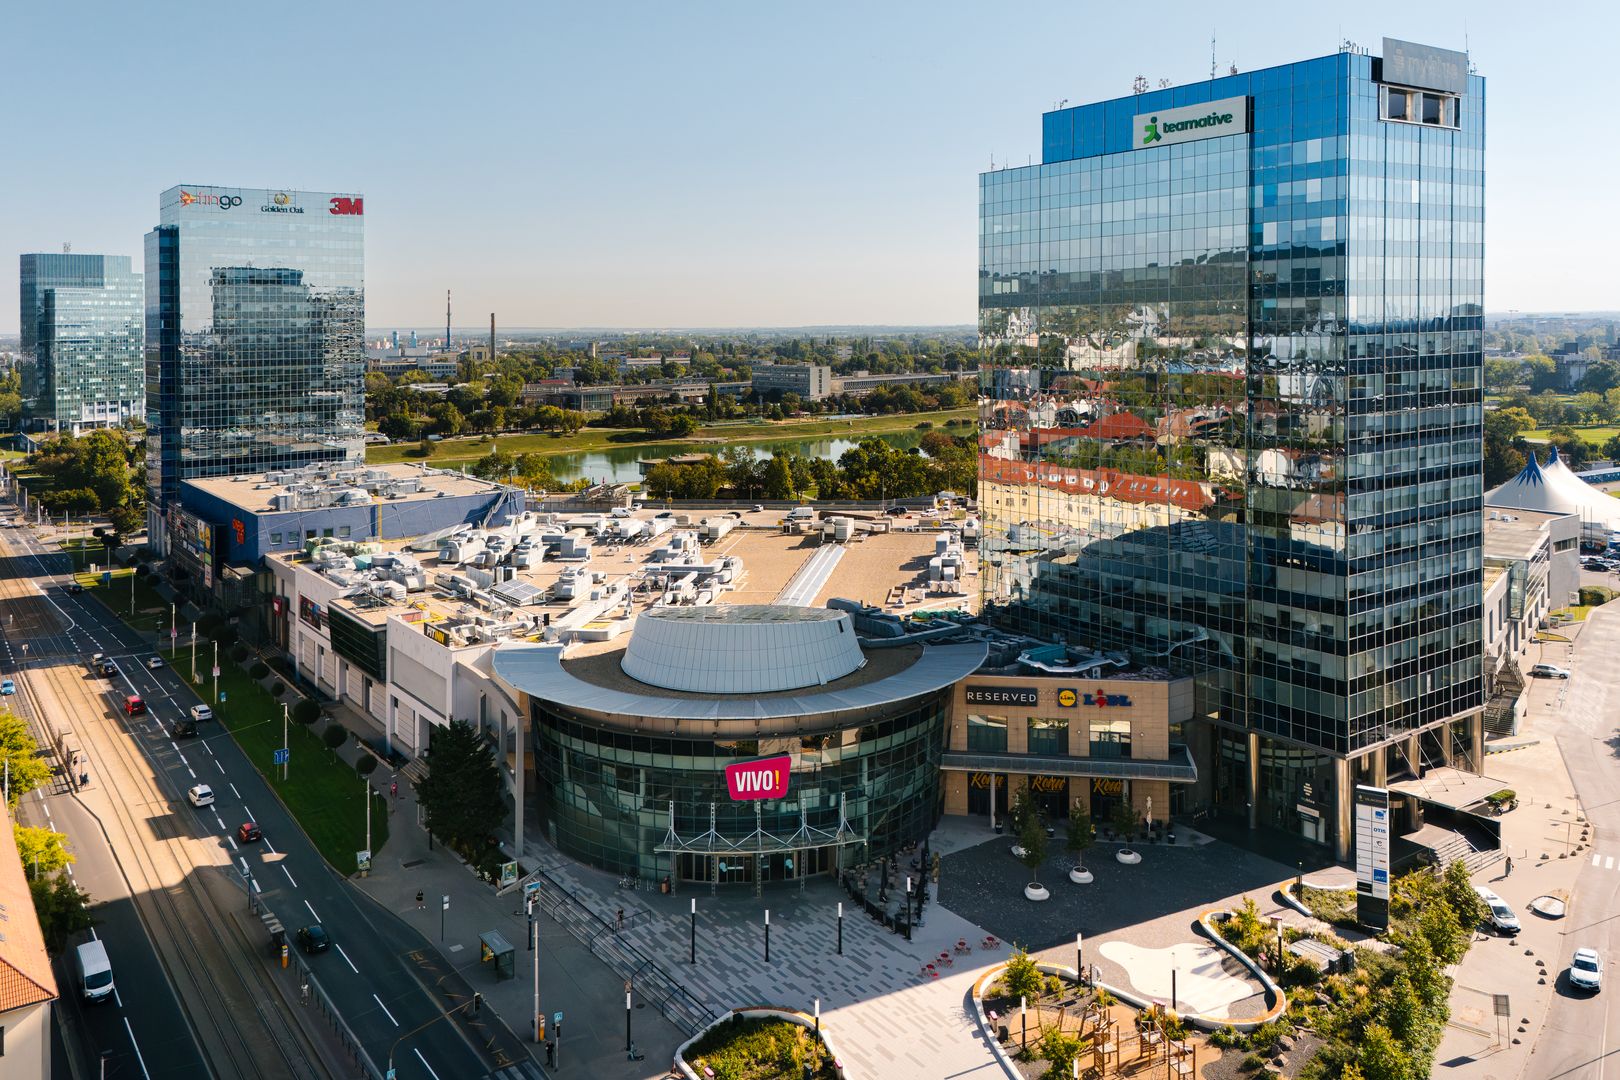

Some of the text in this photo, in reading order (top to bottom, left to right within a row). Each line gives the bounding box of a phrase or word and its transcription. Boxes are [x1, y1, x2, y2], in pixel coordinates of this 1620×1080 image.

[1163, 111, 1233, 134] teamative
[260, 205, 305, 214] Golden Oak
[329, 197, 364, 216] 3M
[967, 691, 1037, 703] RESERVED
[735, 769, 780, 793] VIVO!
